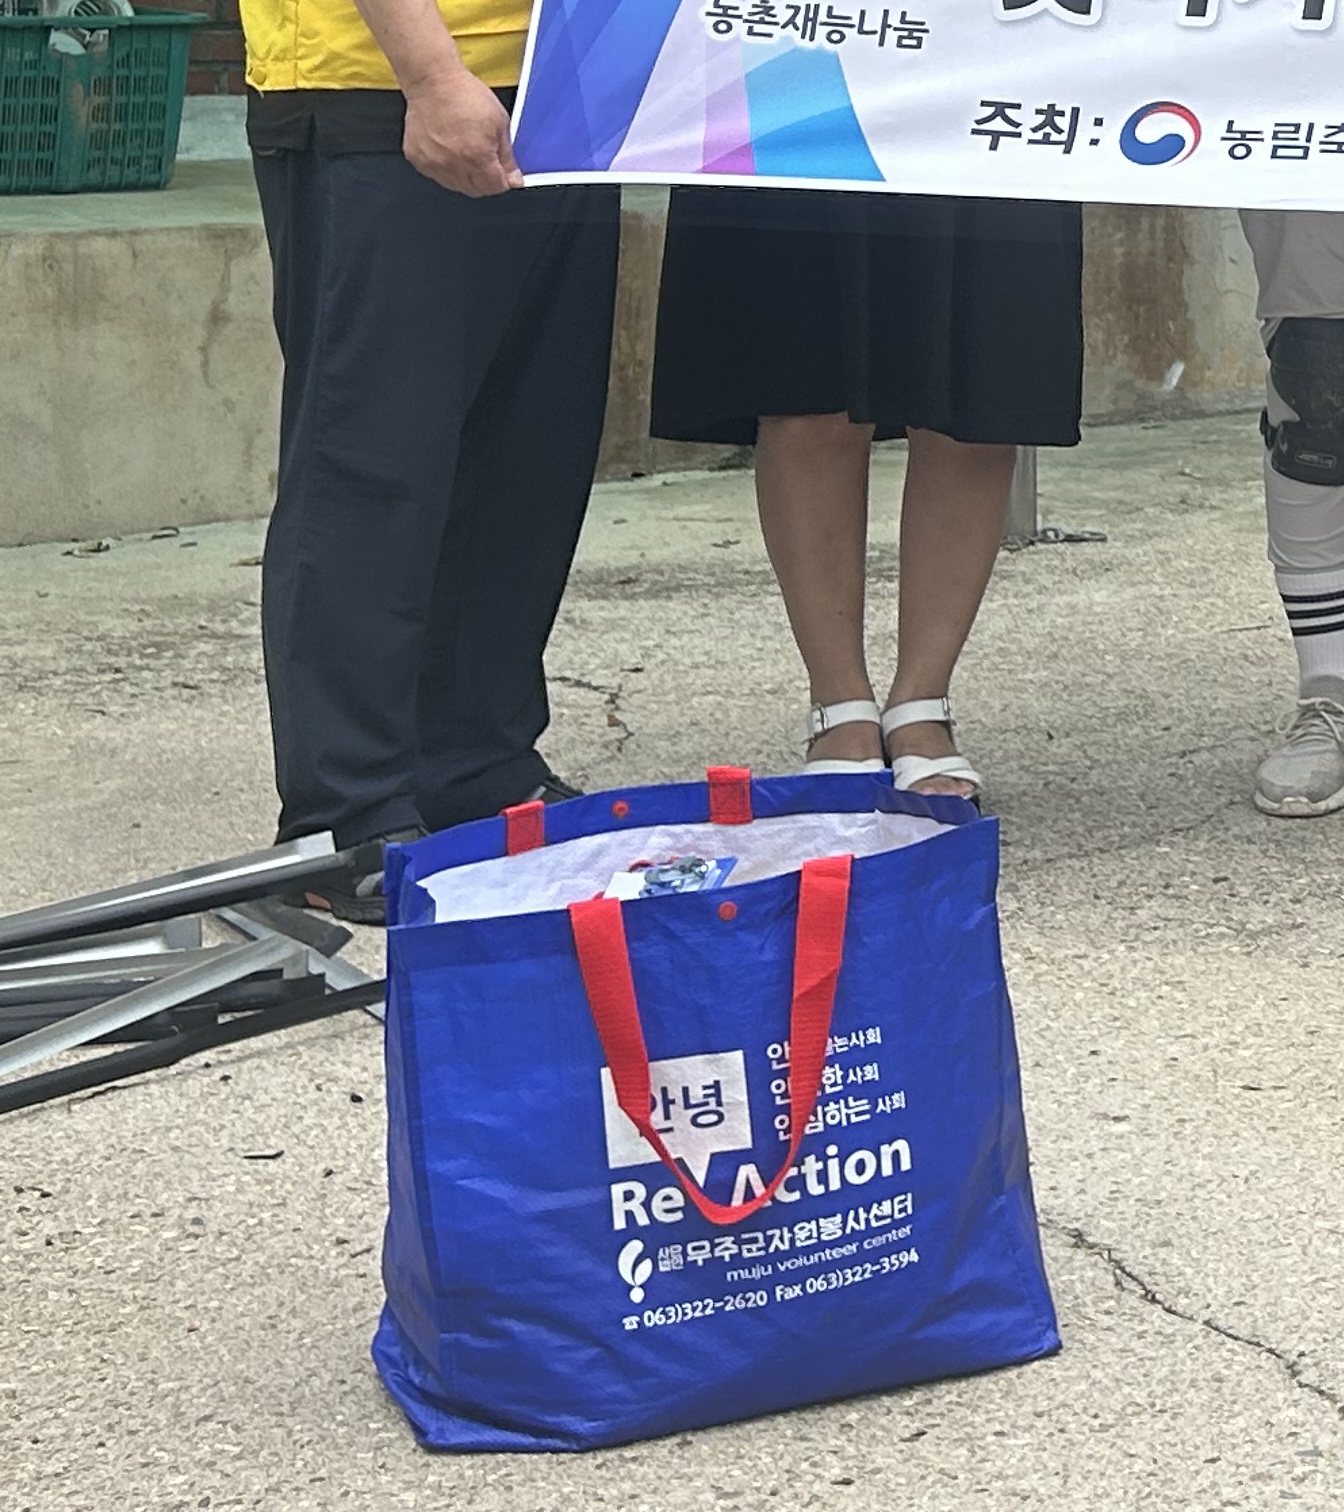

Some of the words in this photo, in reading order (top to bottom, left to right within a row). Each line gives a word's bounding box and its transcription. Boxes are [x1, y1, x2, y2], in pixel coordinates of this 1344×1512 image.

[970, 100, 1104, 154] 주최:
[875, 1091, 906, 1114] 사회
[610, 1180, 685, 1231] Re
[687, 1193, 913, 1267] 무주군자원봉사센터
[726, 1262, 772, 1282] muju
[778, 1241, 859, 1272] volunteer
[863, 1223, 913, 1250] center
[643, 1289, 768, 1329] 063)322-2620
[775, 1283, 802, 1302] Fax
[805, 1247, 920, 1294] 063)322-3594
